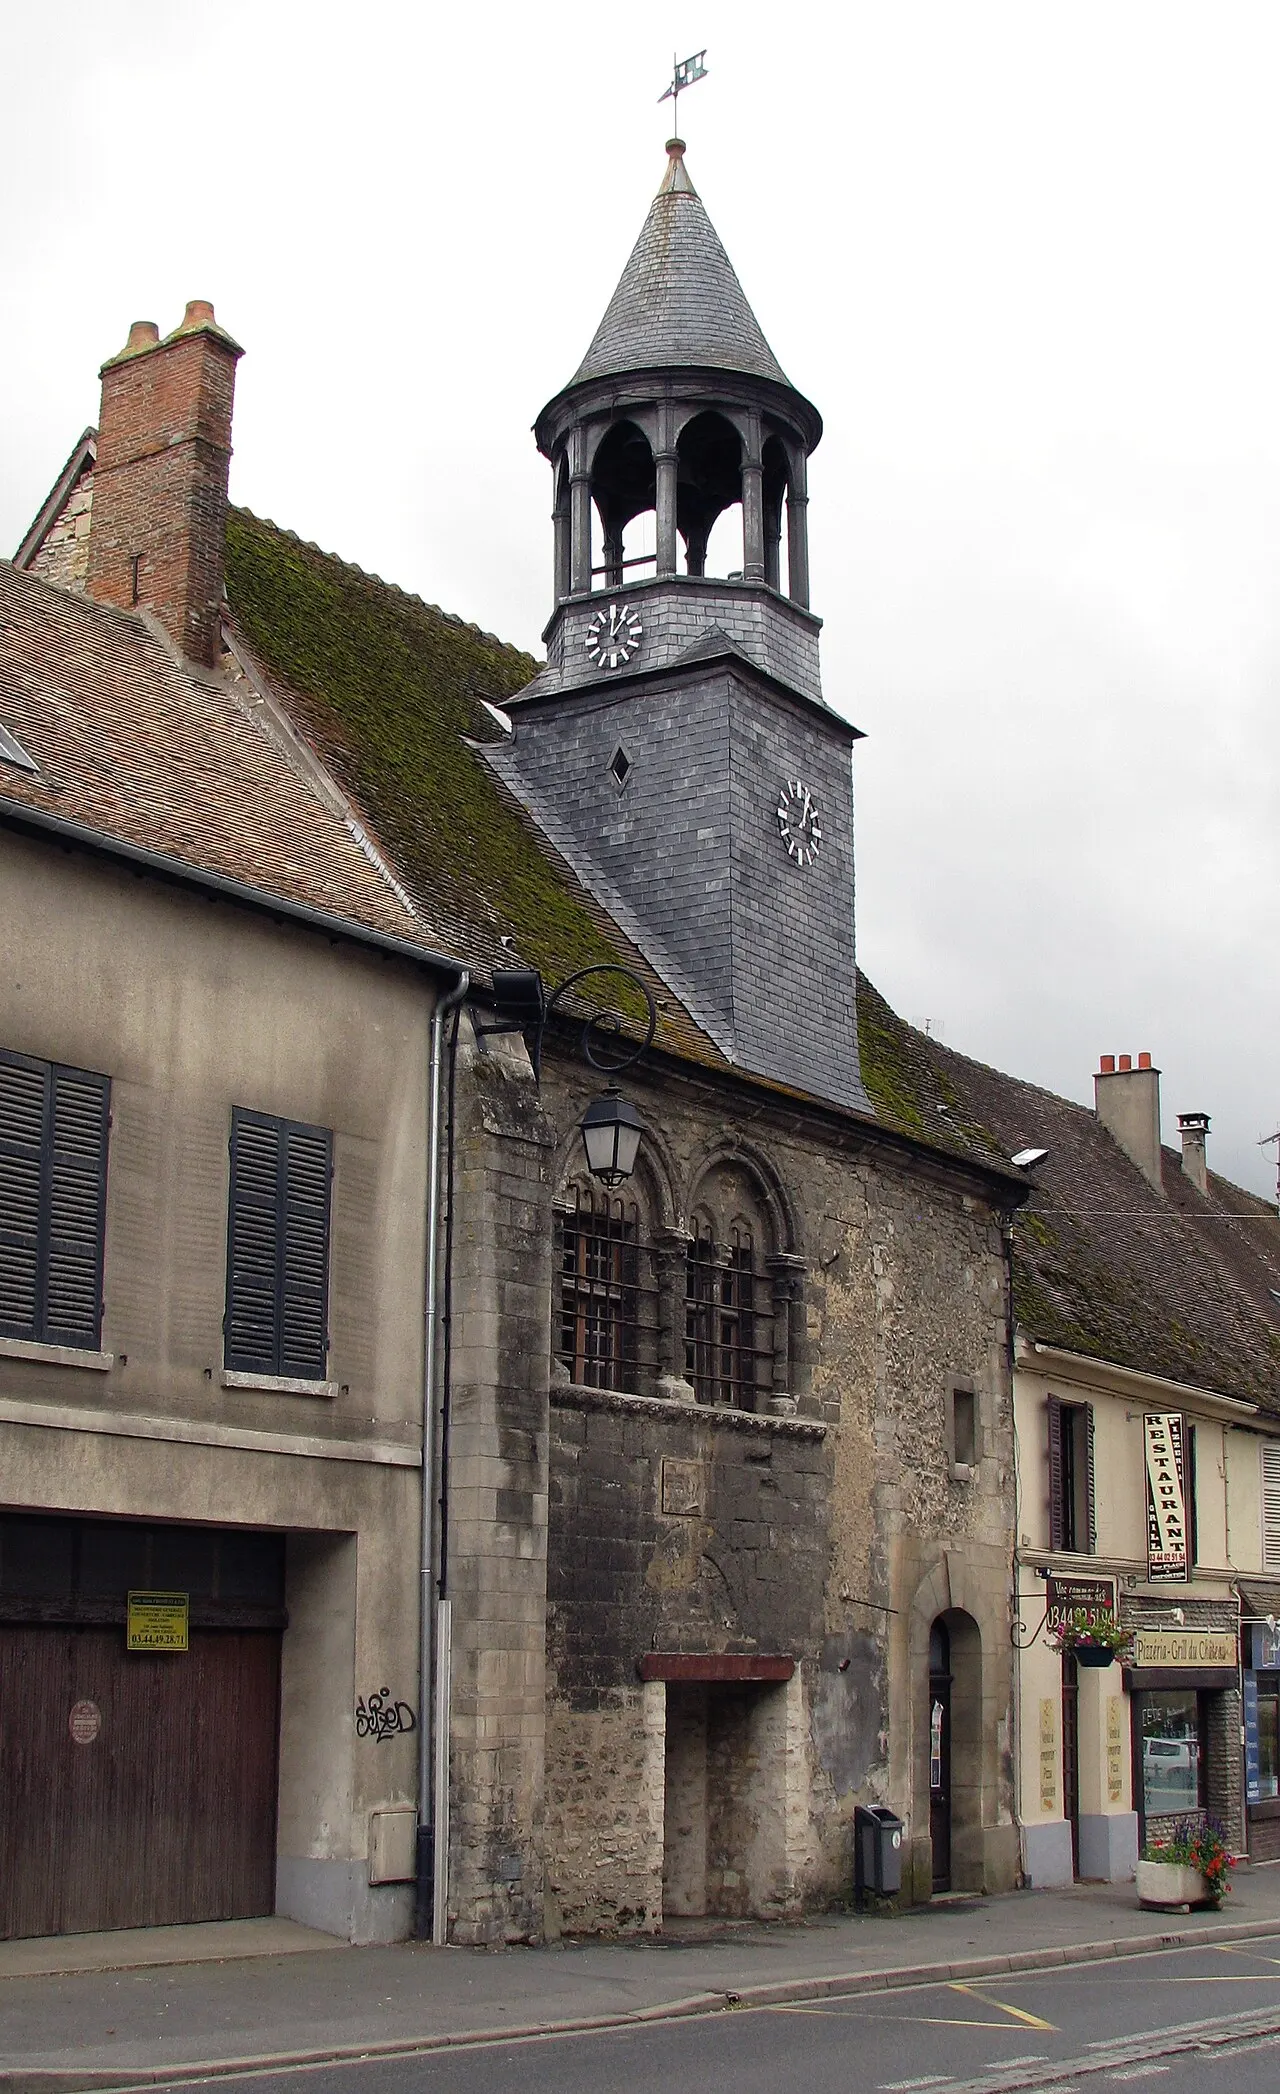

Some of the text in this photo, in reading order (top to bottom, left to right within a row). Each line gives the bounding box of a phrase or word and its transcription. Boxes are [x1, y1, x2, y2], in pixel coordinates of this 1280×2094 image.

[1146, 1416, 1184, 1551] RESTAURANT
[1149, 1504, 1161, 1550] GRILL
[1157, 1552, 1163, 1561] 44
[131, 1634, 184, 1644] 03.44.49.28.71
[1188, 1639, 1198, 1660] du
